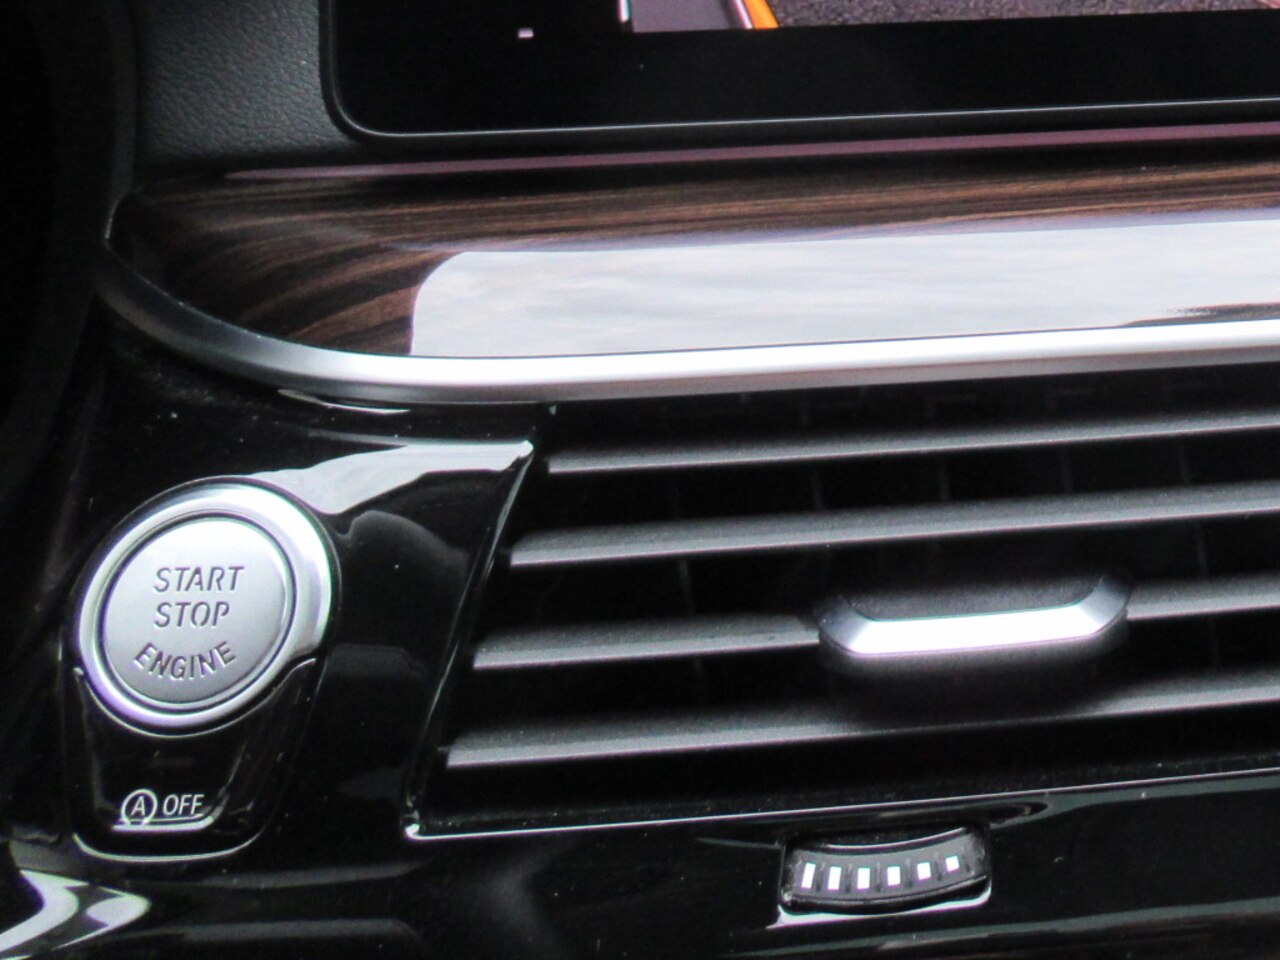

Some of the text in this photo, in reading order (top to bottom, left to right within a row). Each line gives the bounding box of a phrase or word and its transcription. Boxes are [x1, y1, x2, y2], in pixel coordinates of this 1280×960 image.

[153, 565, 246, 593] START
[153, 600, 231, 629] STOP
[134, 640, 238, 681] ENGINE
[162, 793, 206, 817] OFF
